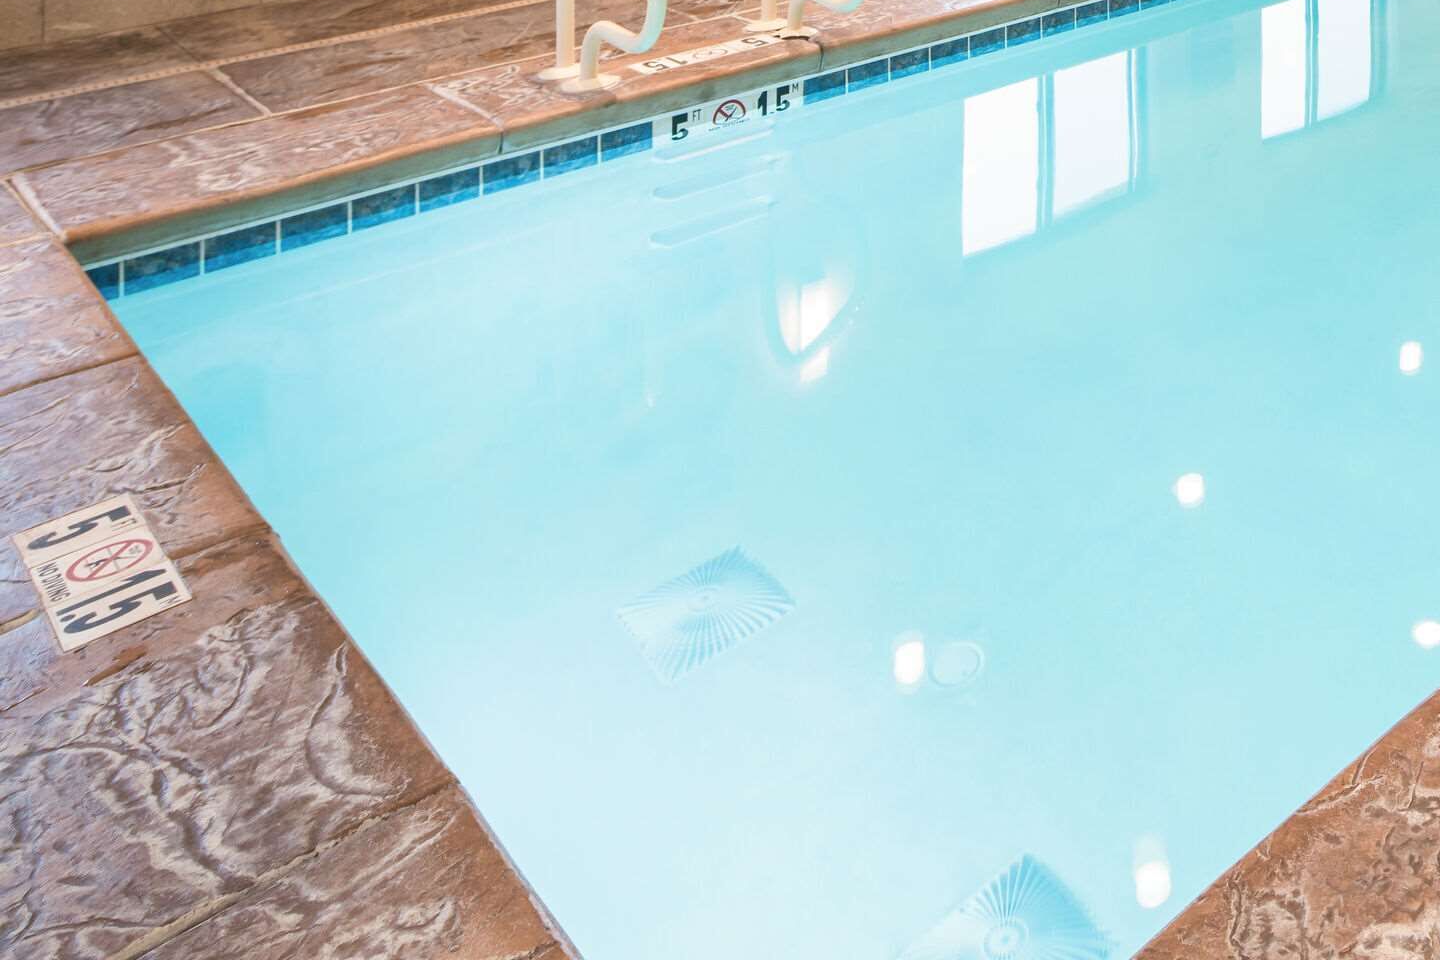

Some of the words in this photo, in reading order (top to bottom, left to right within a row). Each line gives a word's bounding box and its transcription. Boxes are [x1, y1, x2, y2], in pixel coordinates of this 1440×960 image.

[671, 112, 689, 141] 5
[692, 108, 702, 121] FT
[792, 83, 799, 93] M
[27, 505, 132, 550] 5
[37, 561, 60, 577] NO
[42, 573, 71, 603] DIVING
[56, 568, 178, 634] 1.5
